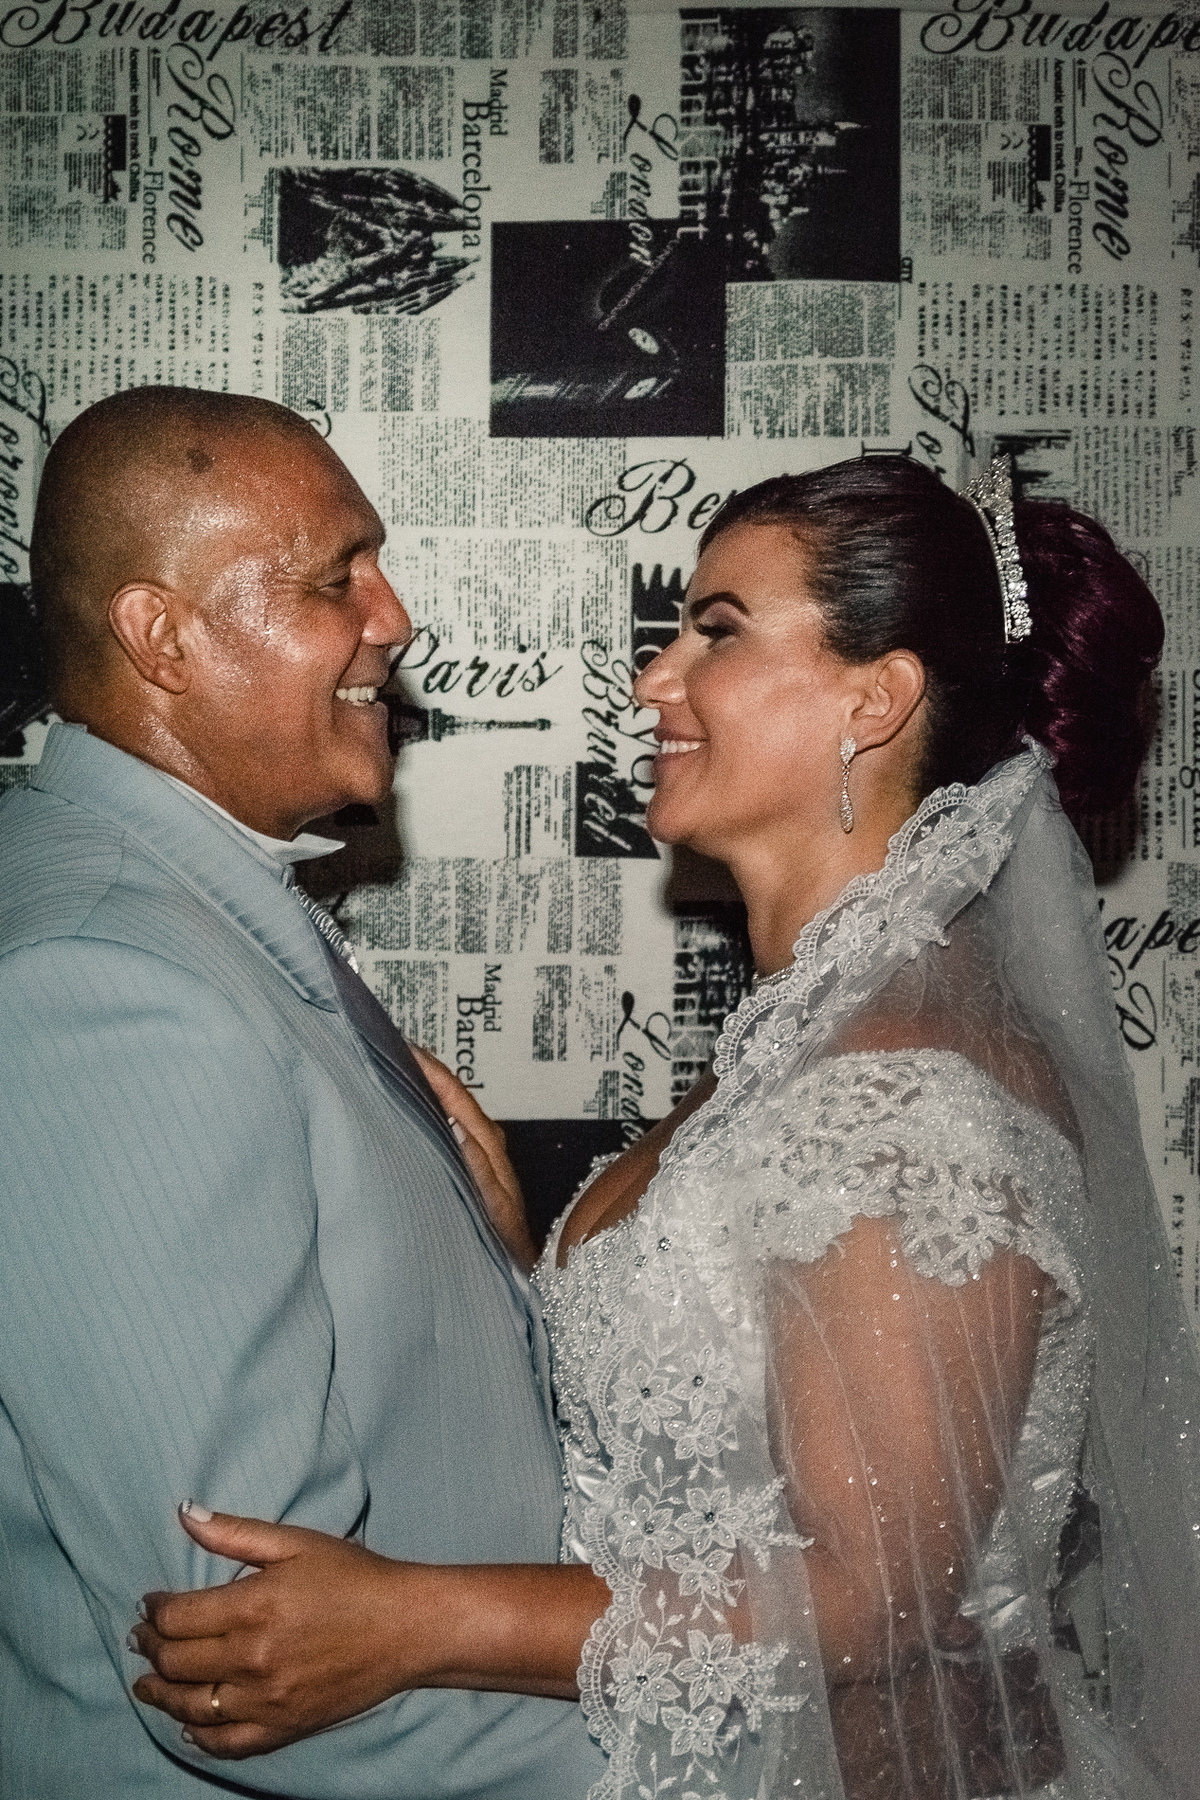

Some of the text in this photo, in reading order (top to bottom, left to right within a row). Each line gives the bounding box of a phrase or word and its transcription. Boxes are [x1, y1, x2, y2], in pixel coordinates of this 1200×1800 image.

[0, 0, 353, 62] Budapest
[489, 68, 508, 137] Madrid
[1054, 57, 1066, 104] Acoustic
[128, 119, 141, 131] to
[166, 43, 236, 253] Rome
[1054, 106, 1066, 128] tech
[1054, 130, 1066, 142] to
[462, 99, 491, 249] Barcelona
[623, 94, 679, 267] London
[1054, 143, 1066, 171] track
[1092, 52, 1164, 261] Rome
[142, 170, 164, 264] Florence
[1067, 180, 1090, 275] Florence
[901, 256, 913, 285] CITY
[385, 624, 564, 698] Paris
[483, 963, 503, 1033] Madrid
